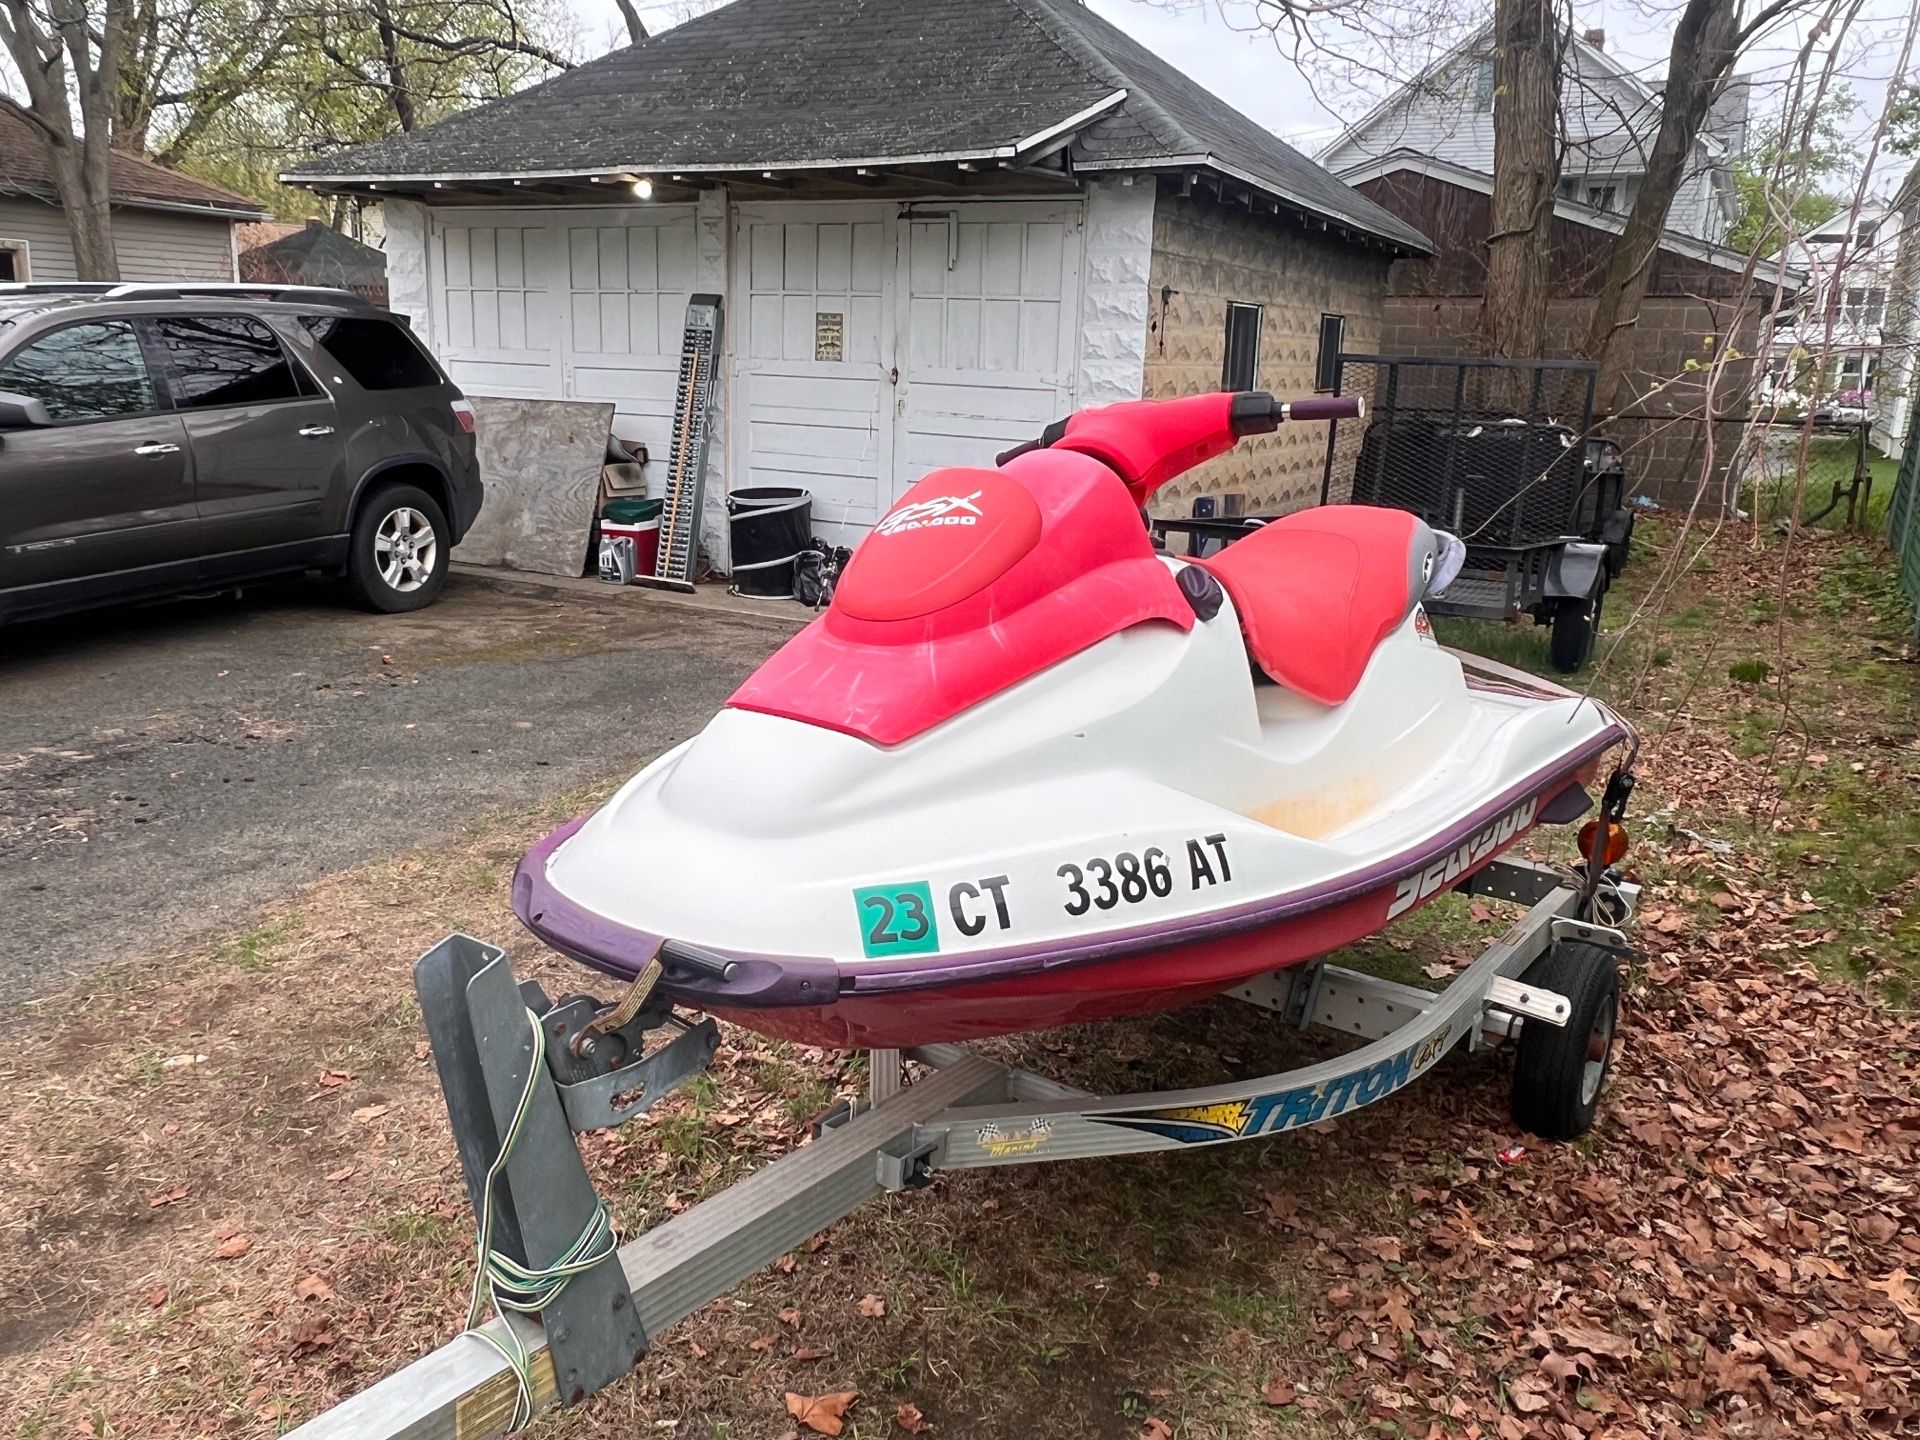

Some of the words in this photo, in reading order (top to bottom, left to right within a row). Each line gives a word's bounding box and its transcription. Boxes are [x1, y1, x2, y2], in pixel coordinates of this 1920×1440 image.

[874, 490, 983, 533] GSX
[864, 893, 929, 944] 23
[949, 875, 1011, 937] CT
[1056, 847, 1172, 917] 3386
[1185, 833, 1232, 891] AT
[1243, 1043, 1420, 1137] TRITON
